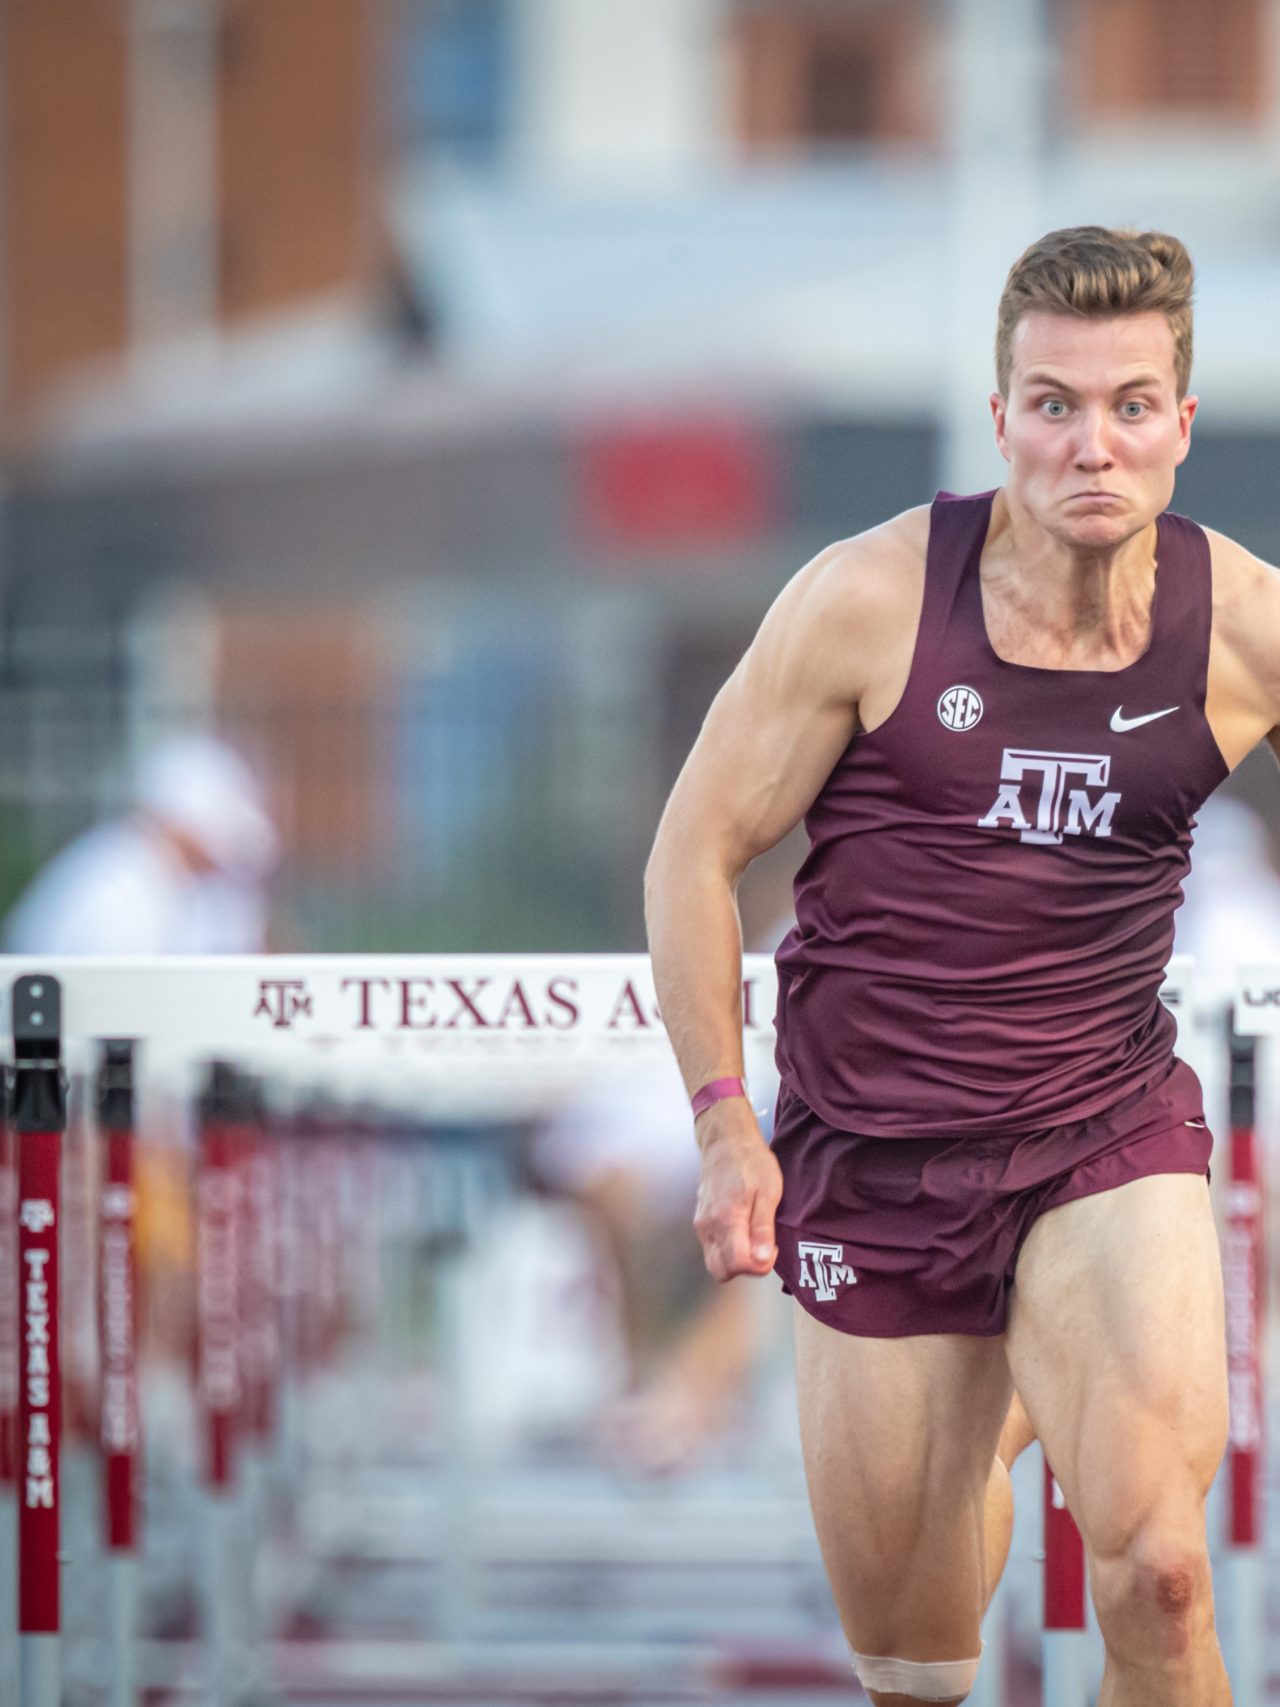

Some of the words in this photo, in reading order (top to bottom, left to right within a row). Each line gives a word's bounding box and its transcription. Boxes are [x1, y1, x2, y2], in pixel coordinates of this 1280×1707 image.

[940, 688, 981, 730] SEC
[340, 977, 582, 1030] TEXAS
[24, 1248, 50, 1407] TEXAS
